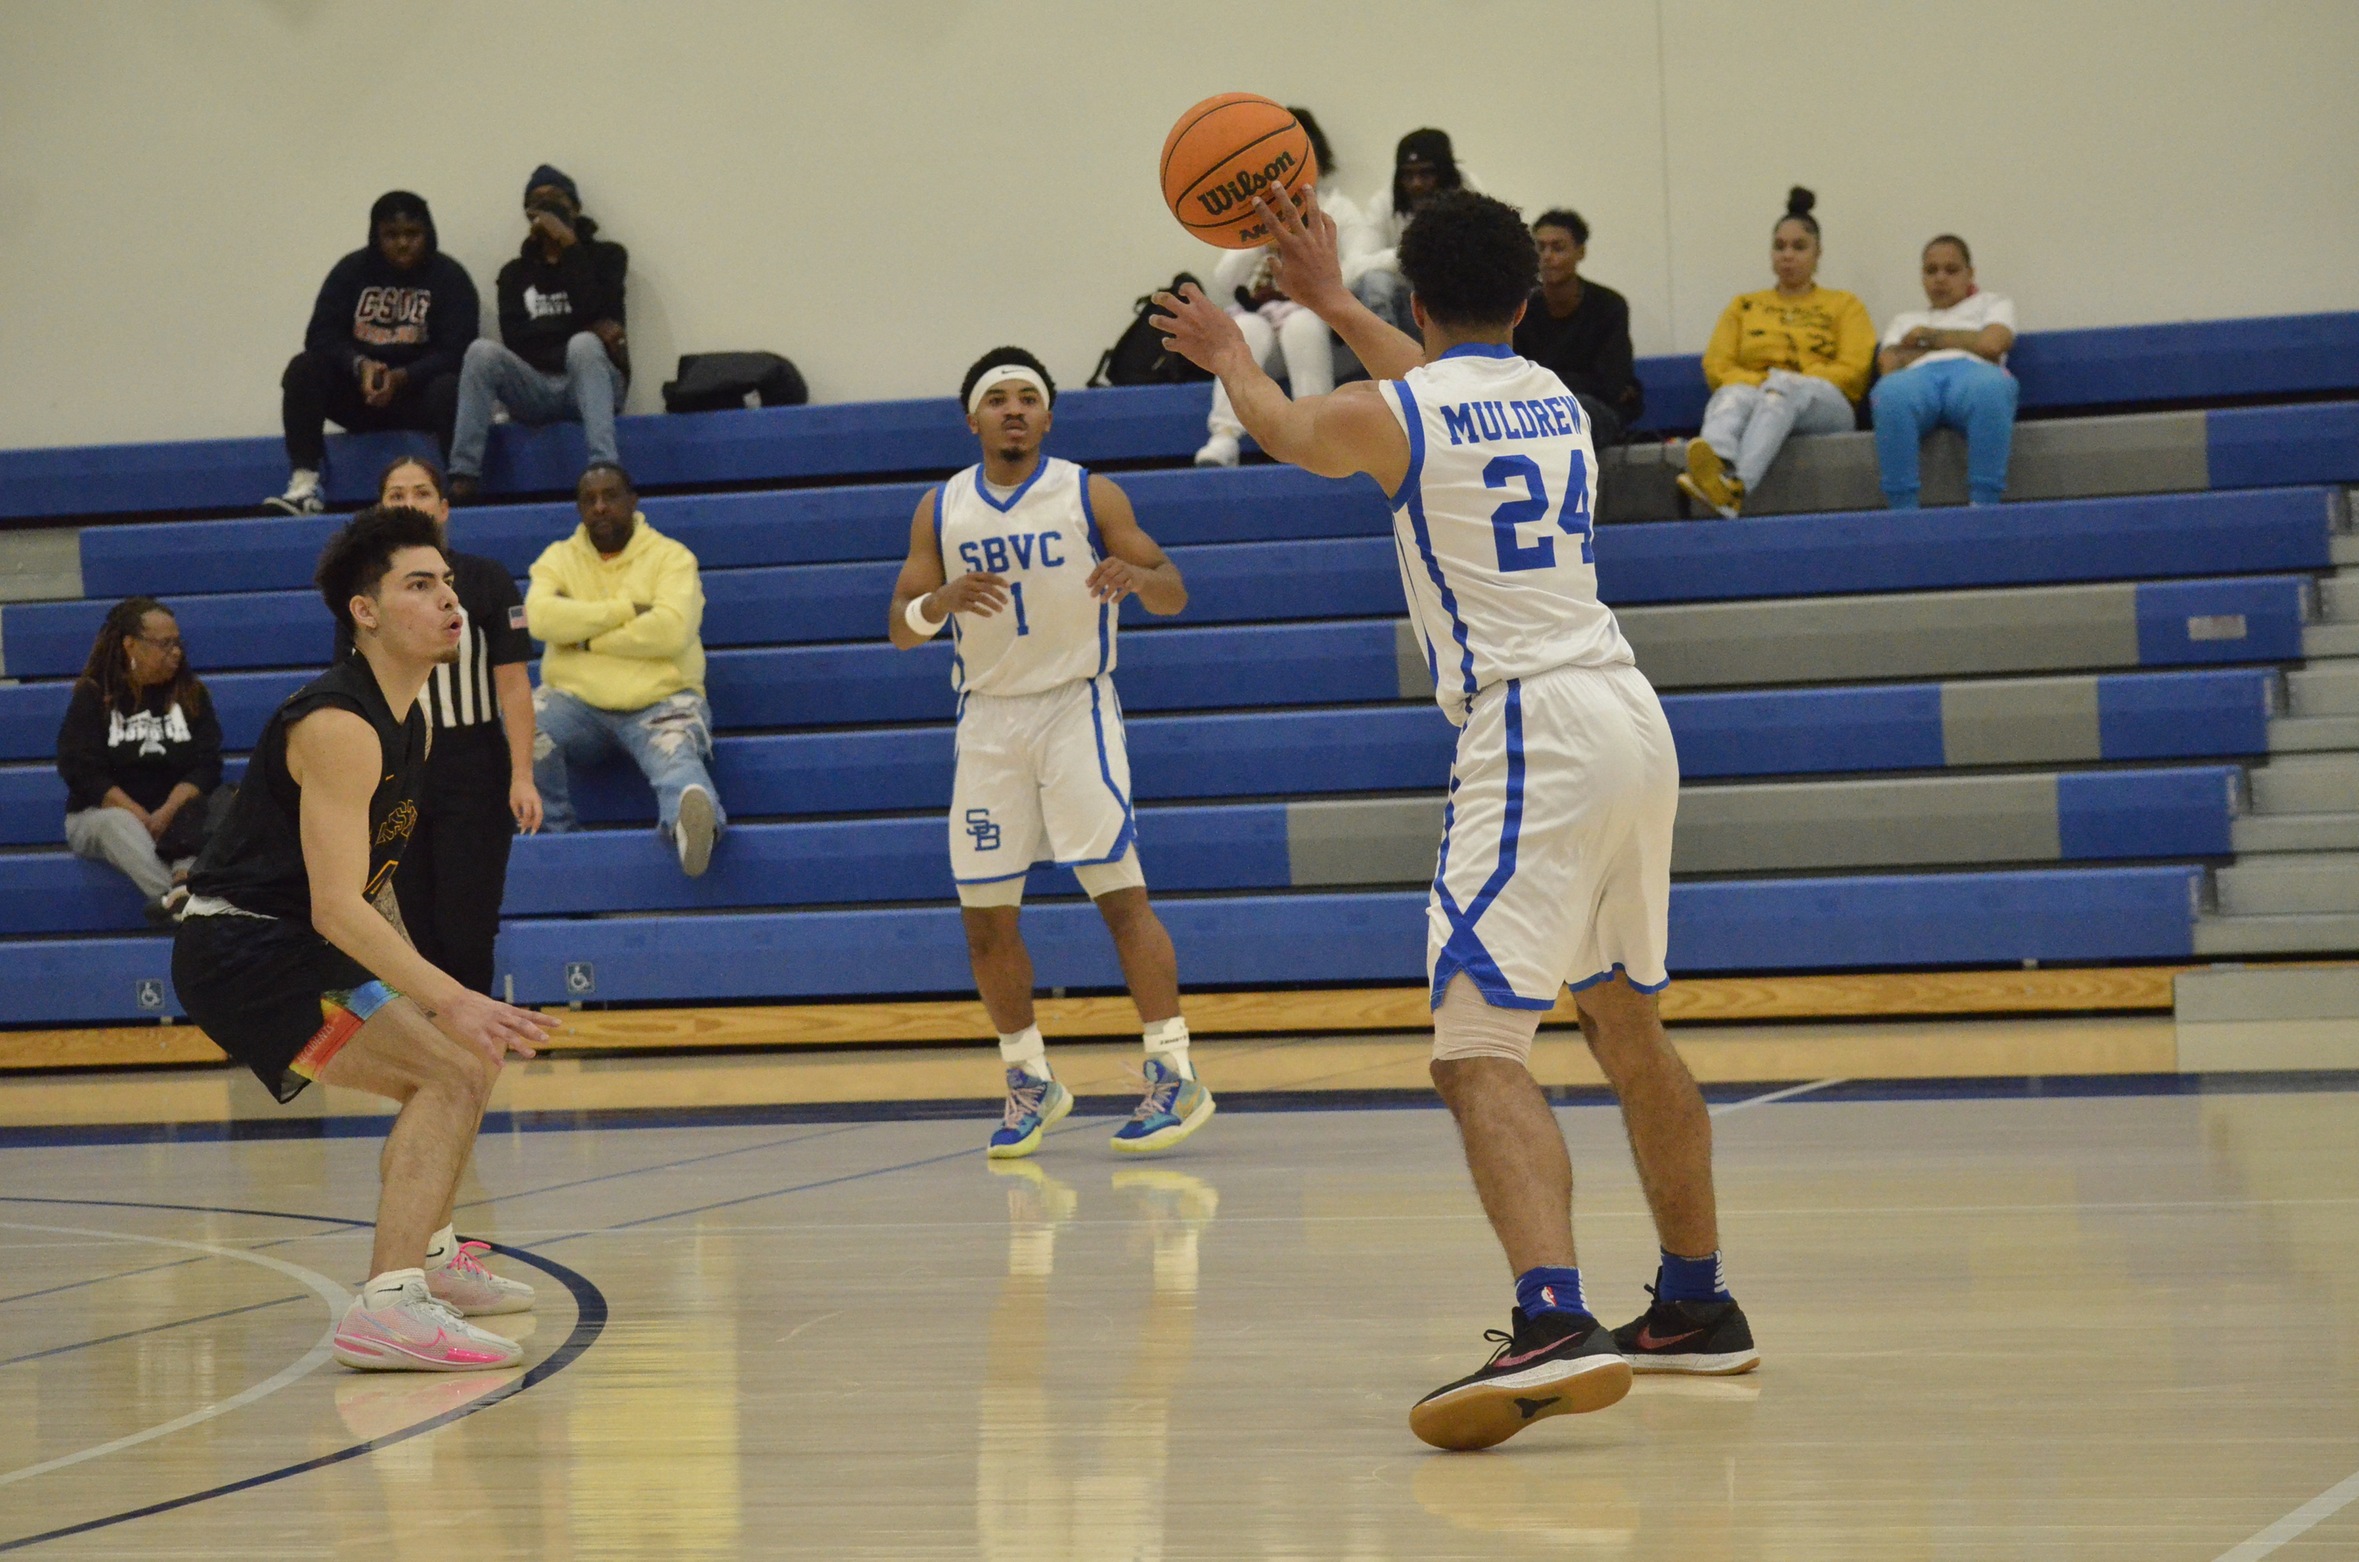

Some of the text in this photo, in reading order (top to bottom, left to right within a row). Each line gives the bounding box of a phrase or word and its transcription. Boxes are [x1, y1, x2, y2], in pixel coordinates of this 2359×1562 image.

[1196, 151, 1296, 215] Wilson
[1439, 395, 1590, 446] MULDREW
[1482, 449, 1595, 573] 24
[959, 530, 1065, 574] SBVC
[1010, 581, 1029, 636] 1
[966, 808, 1000, 851] SB
